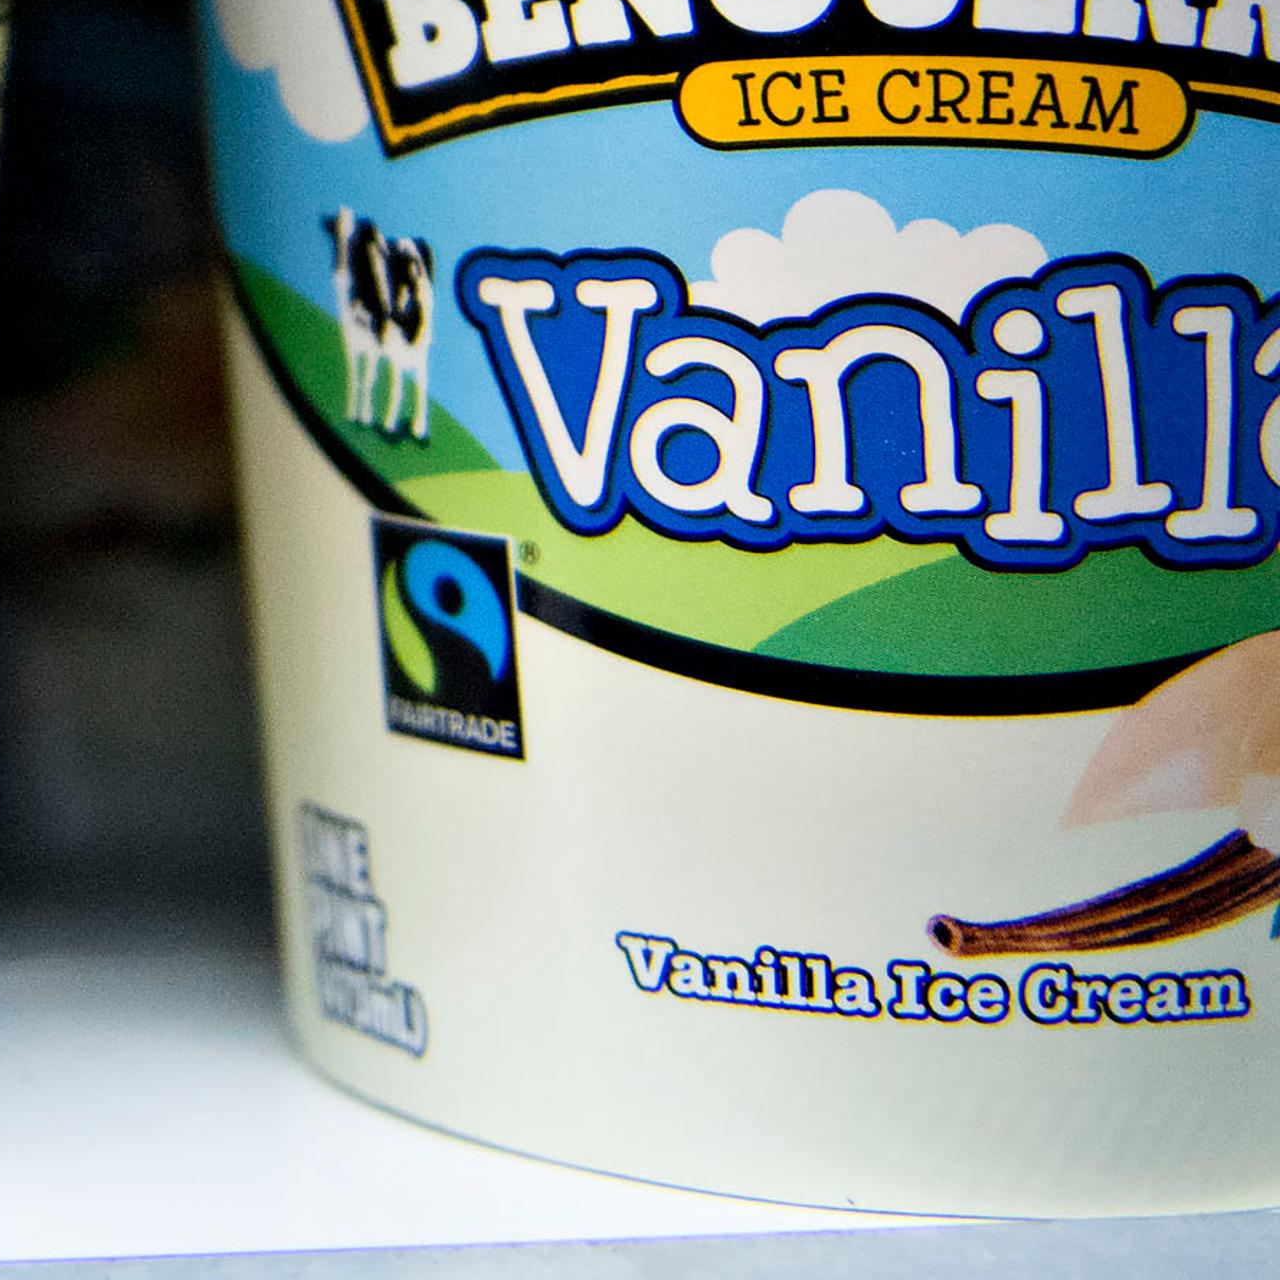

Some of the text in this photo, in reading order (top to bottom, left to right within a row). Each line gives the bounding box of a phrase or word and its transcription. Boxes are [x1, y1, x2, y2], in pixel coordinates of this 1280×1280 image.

[731, 68, 1143, 135] ICE CREAM
[478, 284, 1280, 541] Vanill
[620, 935, 1247, 1024] Vanilla Ice Cream
